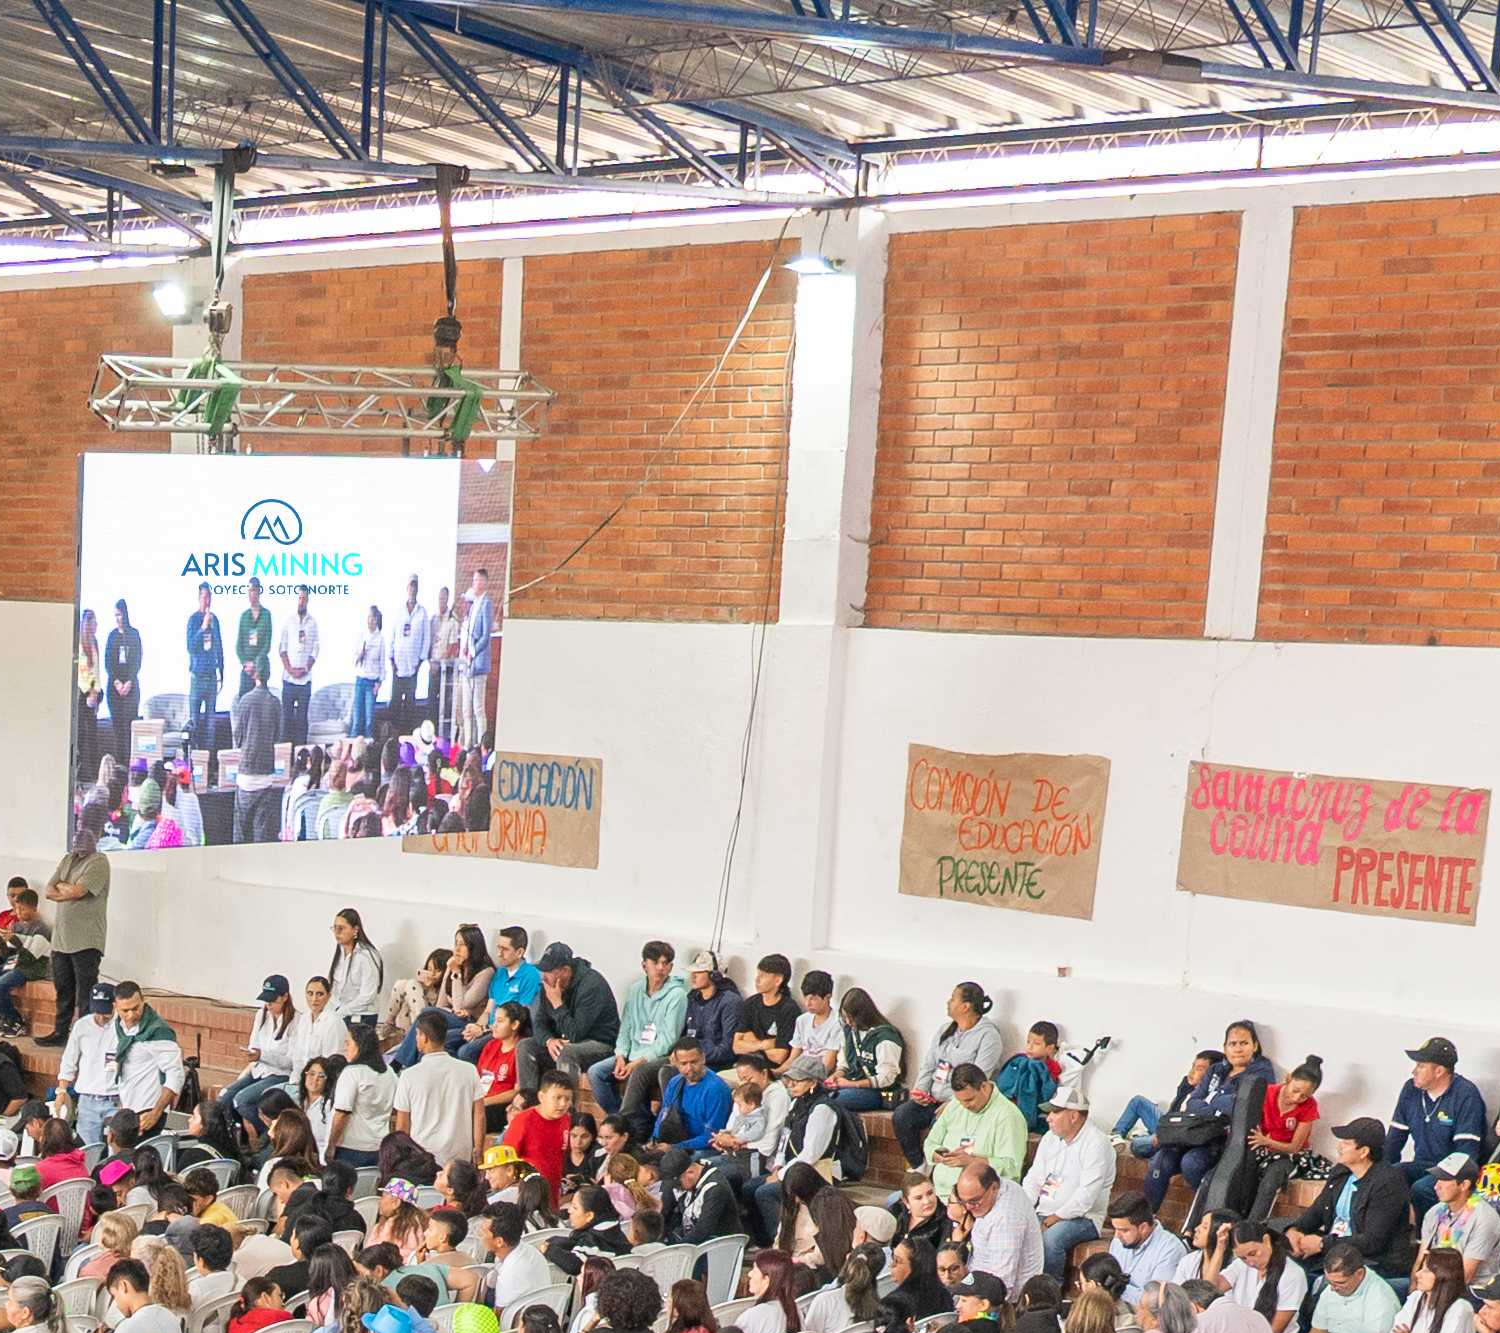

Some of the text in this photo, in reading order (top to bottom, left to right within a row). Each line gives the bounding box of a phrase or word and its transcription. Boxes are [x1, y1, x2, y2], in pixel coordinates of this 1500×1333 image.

[181, 552, 363, 577] ARIS MINING
[308, 585, 350, 595] NORTE
[499, 760, 594, 811] EDUCACIÓN
[910, 758, 1070, 821] COMISIÓN DE
[1384, 783, 1432, 834] de
[1439, 786, 1486, 836] la
[958, 813, 1092, 857] EDUCACIÓN
[937, 855, 1046, 900] PRESENTE
[1331, 846, 1477, 916] PRESENTE
